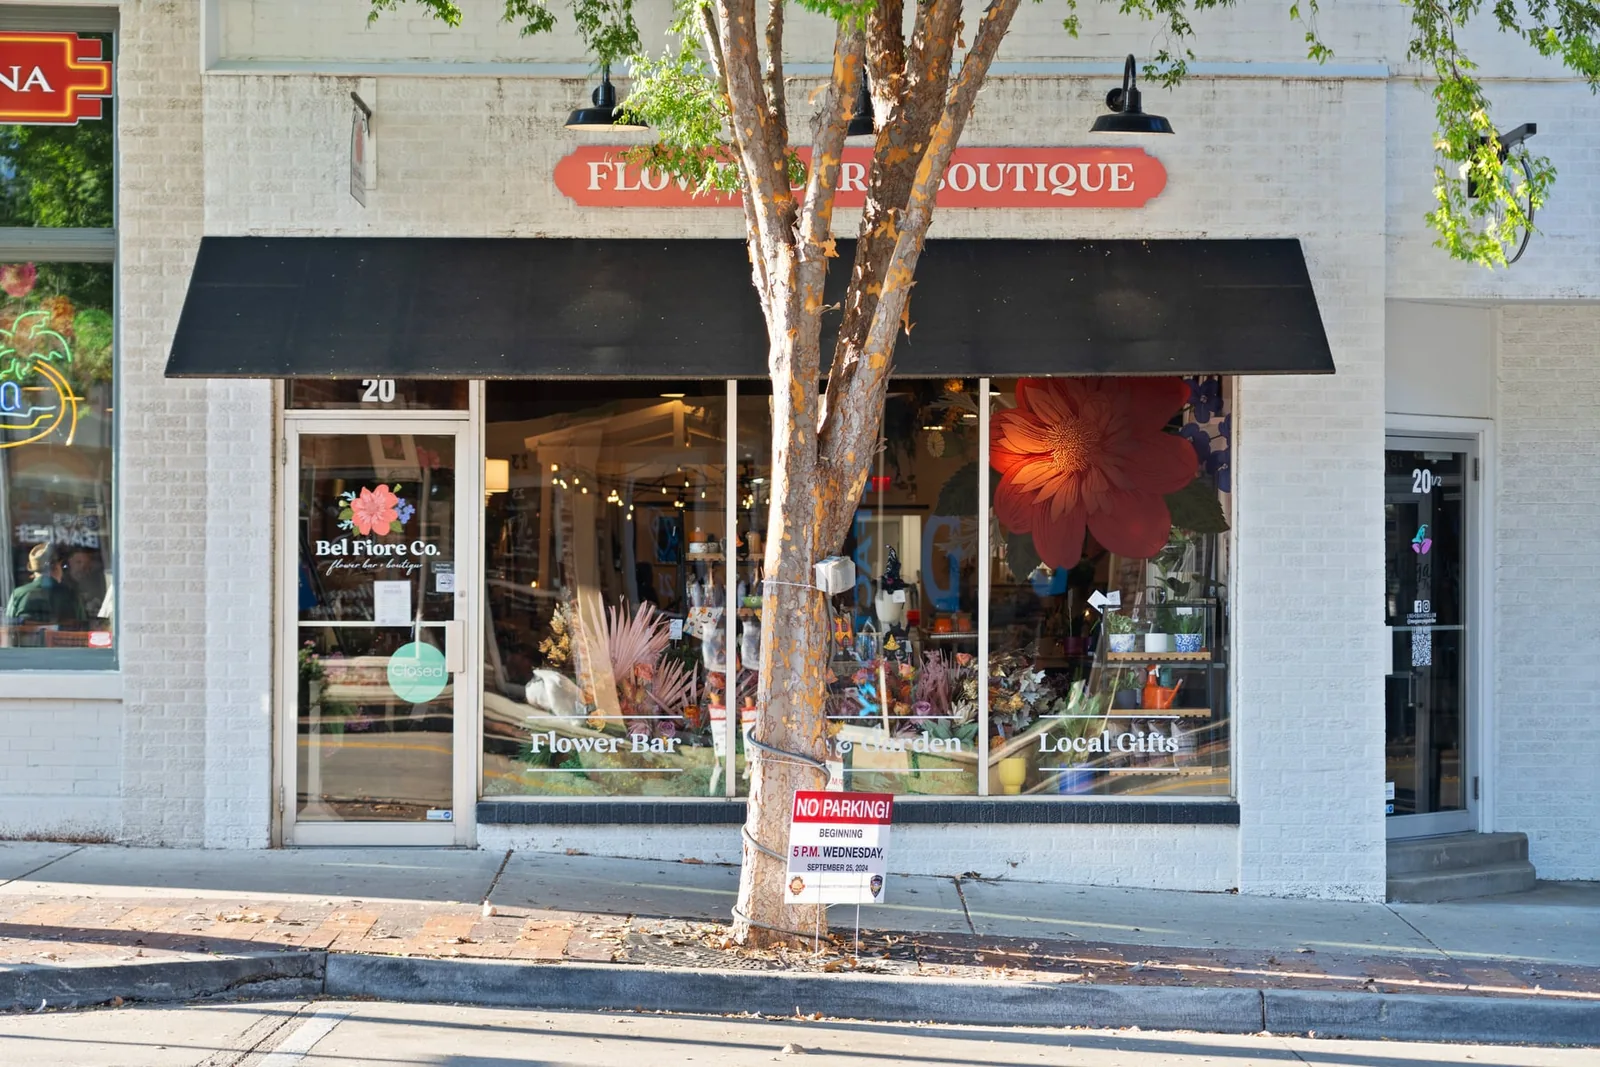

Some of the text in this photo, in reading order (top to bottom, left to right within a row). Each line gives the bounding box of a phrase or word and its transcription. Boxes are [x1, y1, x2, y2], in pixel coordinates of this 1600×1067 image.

[937, 163, 1135, 196] OUTIQUE
[361, 379, 396, 403] 20
[315, 538, 441, 556] Bel Fiore Co.
[325, 558, 424, 577] flower bar boutique
[391, 663, 443, 678] Closed
[530, 730, 682, 754] Flower Bar
[860, 731, 964, 754] Garden
[1038, 730, 1180, 753] Local Gifts
[796, 798, 891, 819] NO PARKING!
[819, 828, 863, 839] BEGINNING
[793, 845, 884, 860] 5 P.M. WEDNESDAY,
[807, 863, 869, 873] SEPTEMBER 25, 2024
